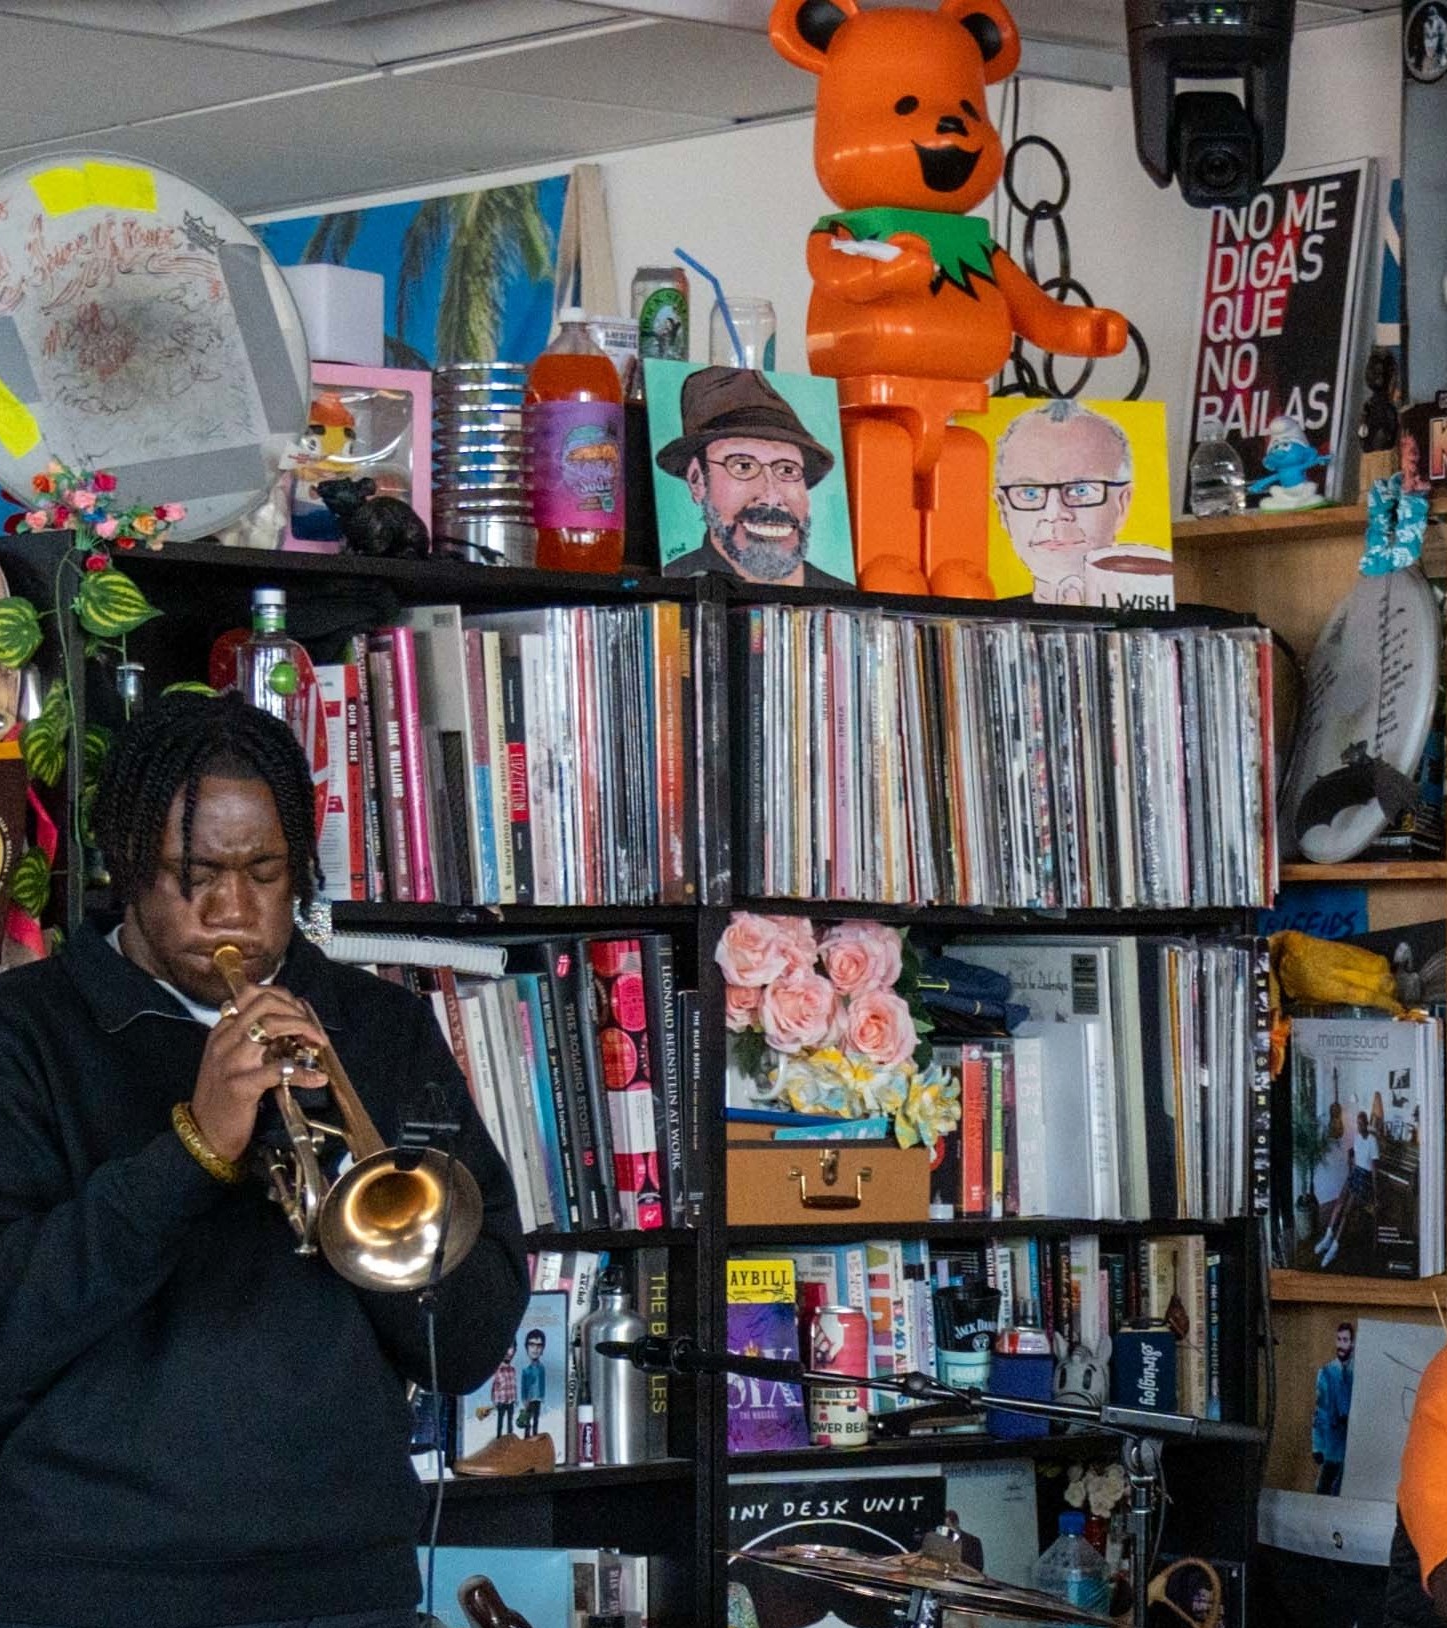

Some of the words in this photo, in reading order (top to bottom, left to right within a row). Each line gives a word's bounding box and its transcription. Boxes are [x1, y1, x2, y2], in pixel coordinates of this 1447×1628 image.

[1217, 192, 1275, 243] NO
[1283, 183, 1336, 233] ME
[1212, 234, 1324, 293] DIGAS
[1206, 295, 1285, 343] QUE
[1202, 345, 1256, 389] NO
[1196, 383, 1330, 440] BAILAS
[1118, 594, 1170, 611] WISH
[349, 703, 358, 726] OUR
[387, 720, 400, 747] HANK
[349, 730, 359, 763] NOISE
[390, 749, 404, 799] WILLIAMS
[661, 964, 675, 1029] LEONARD
[693, 1029, 701, 1049] BLUE
[1316, 1030, 1351, 1050] mirror
[1354, 1031, 1389, 1050] sound
[666, 1032, 680, 1106] BERNSTEIN
[693, 1052, 701, 1080] SERIES
[671, 1128, 683, 1171] WORK
[730, 1268, 793, 1288] AYBILL
[1136, 1341, 1163, 1407] Stringjoy
[783, 1498, 849, 1518] DESK
[863, 1495, 924, 1514] UNIT
